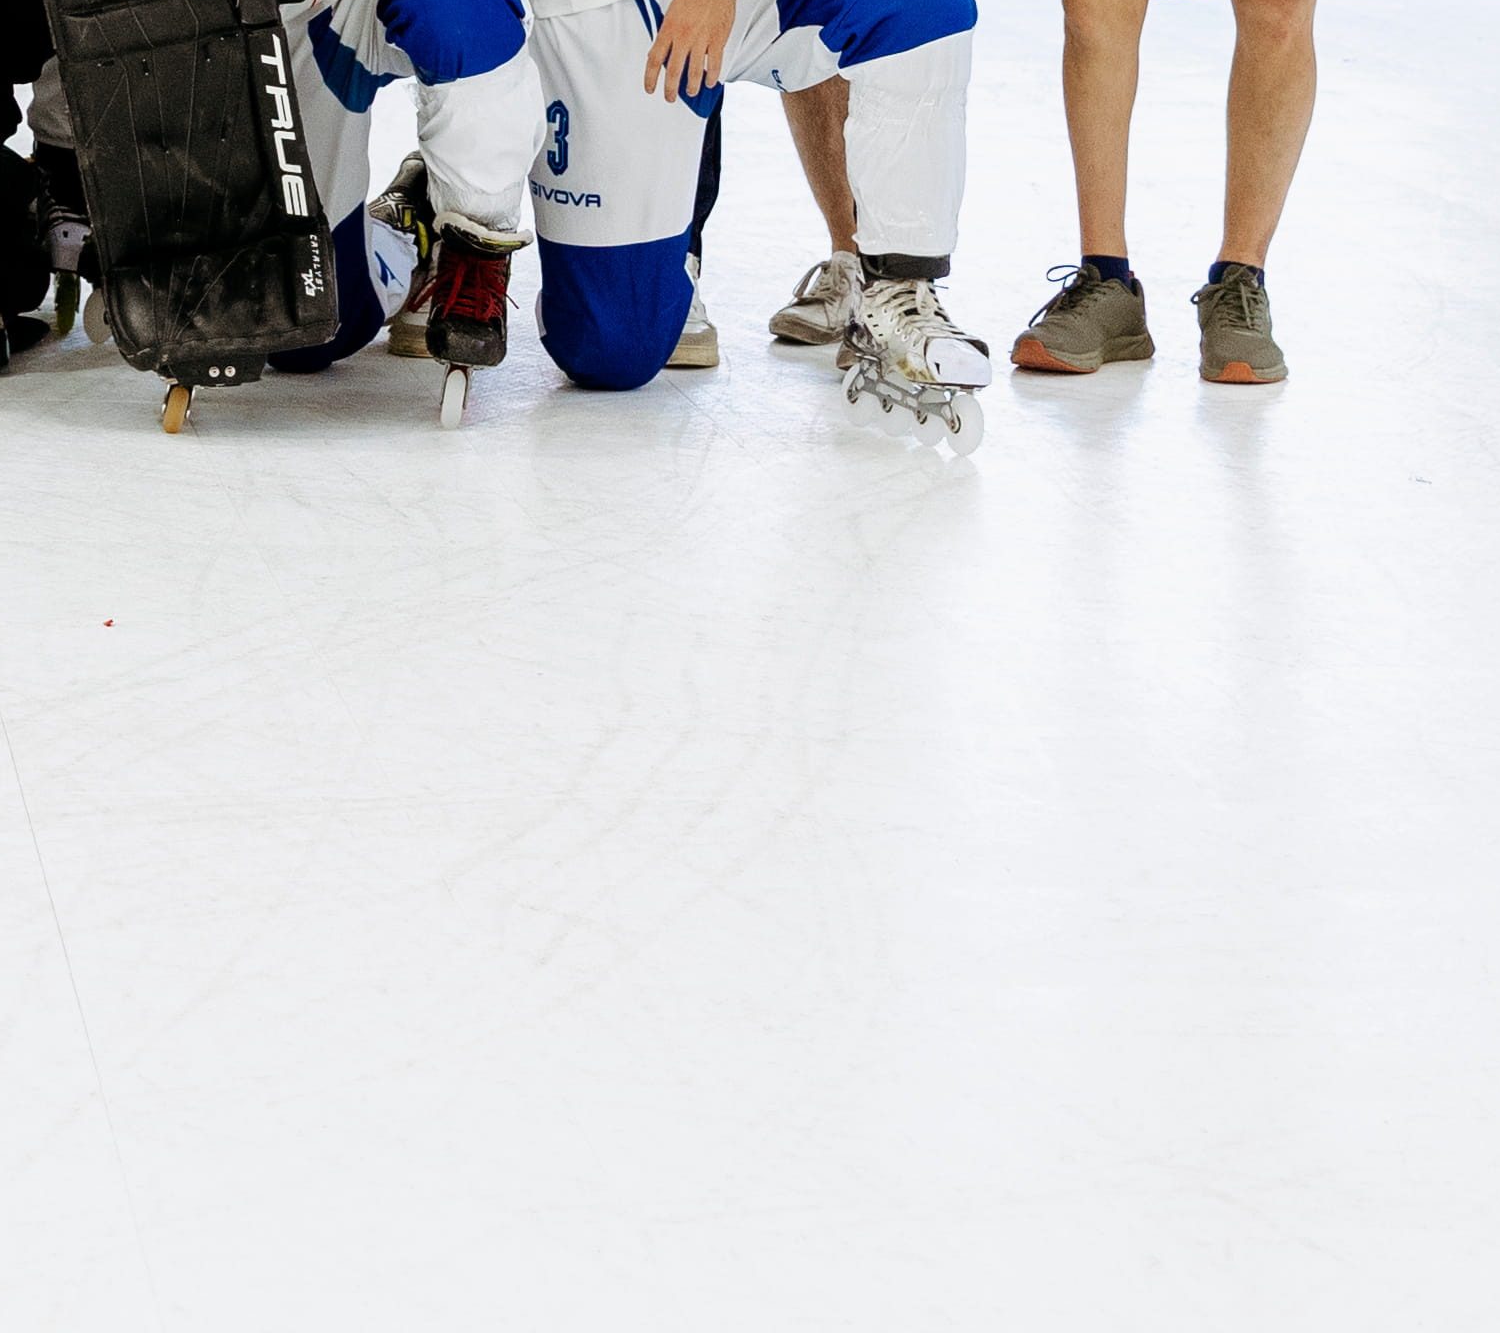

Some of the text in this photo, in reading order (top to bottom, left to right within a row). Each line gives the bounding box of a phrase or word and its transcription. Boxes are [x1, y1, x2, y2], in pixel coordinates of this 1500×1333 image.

[260, 33, 309, 218] TRUE
[546, 99, 570, 176] 3
[309, 234, 324, 293] CATALYST
